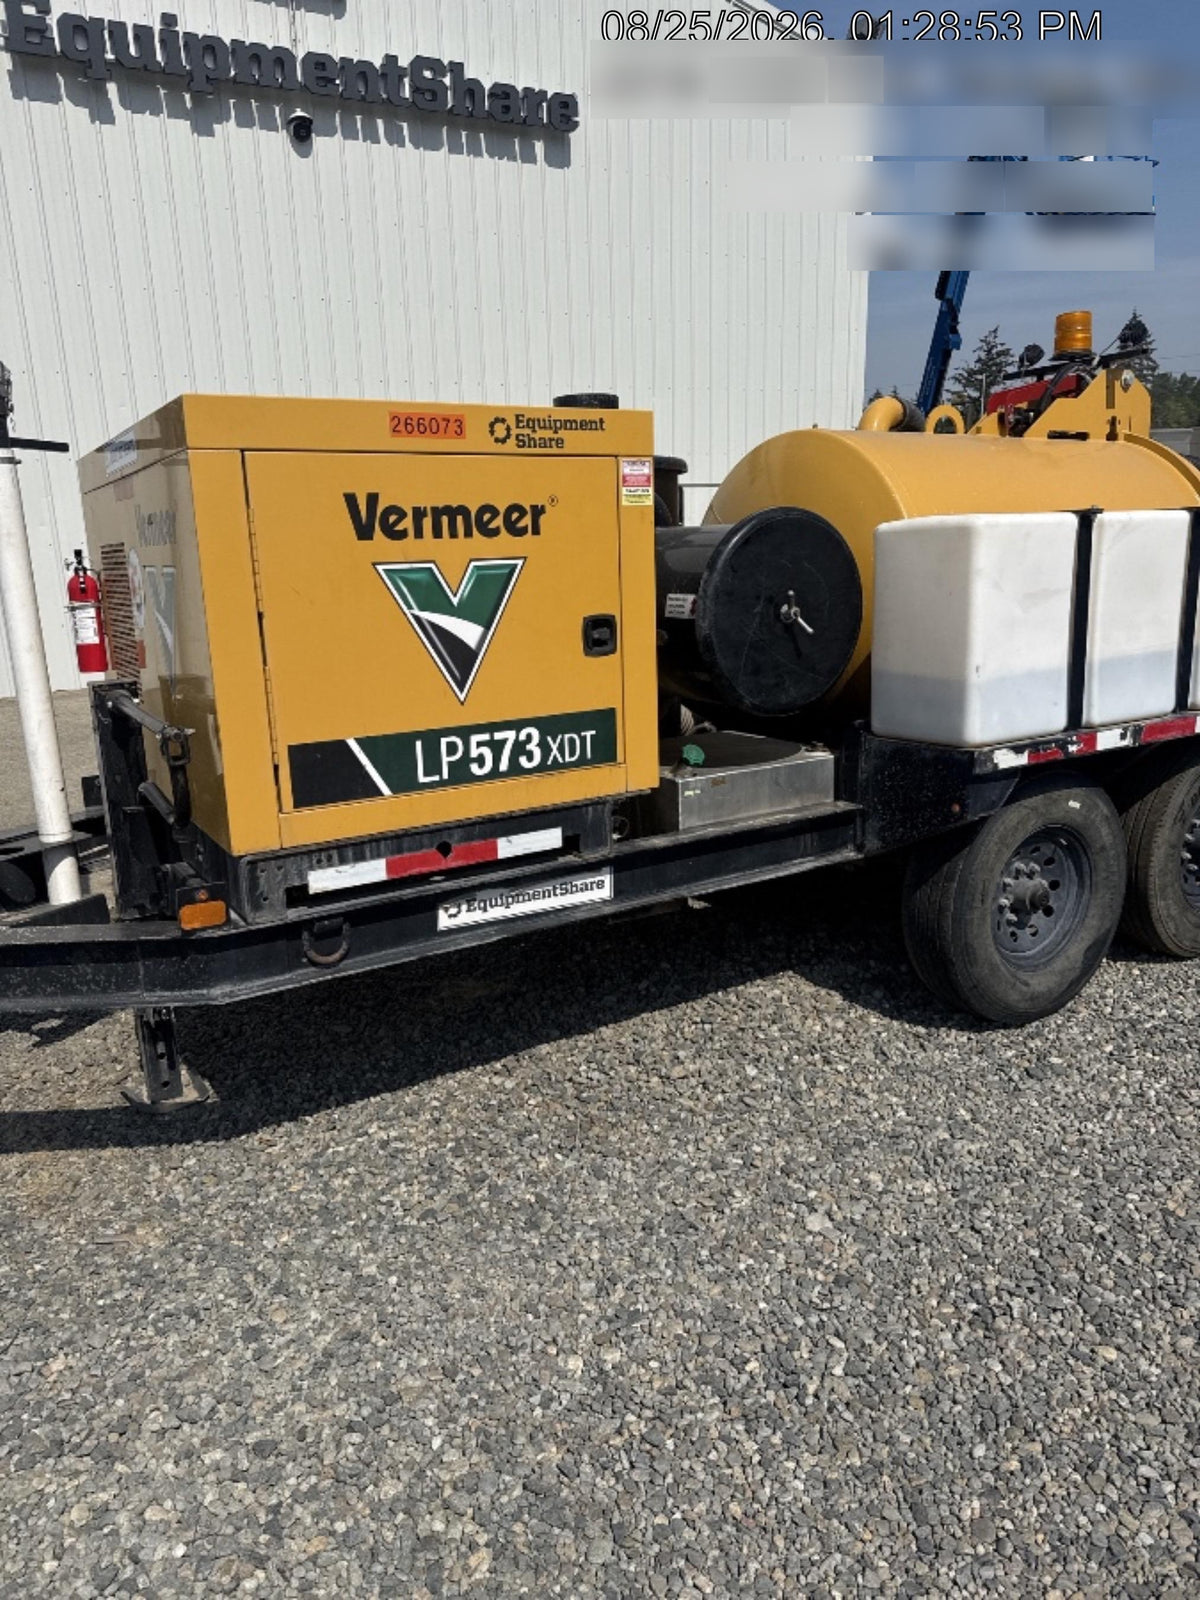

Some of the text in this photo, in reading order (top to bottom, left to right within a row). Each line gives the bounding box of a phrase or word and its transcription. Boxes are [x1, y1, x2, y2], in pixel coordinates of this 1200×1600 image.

[4, 0, 581, 133] EquipmentShare
[391, 415, 464, 436] 266073
[514, 413, 605, 434] Equipment
[514, 433, 564, 449] Share
[342, 491, 546, 541] Vermeer
[461, 878, 605, 914] EquipmentShare
